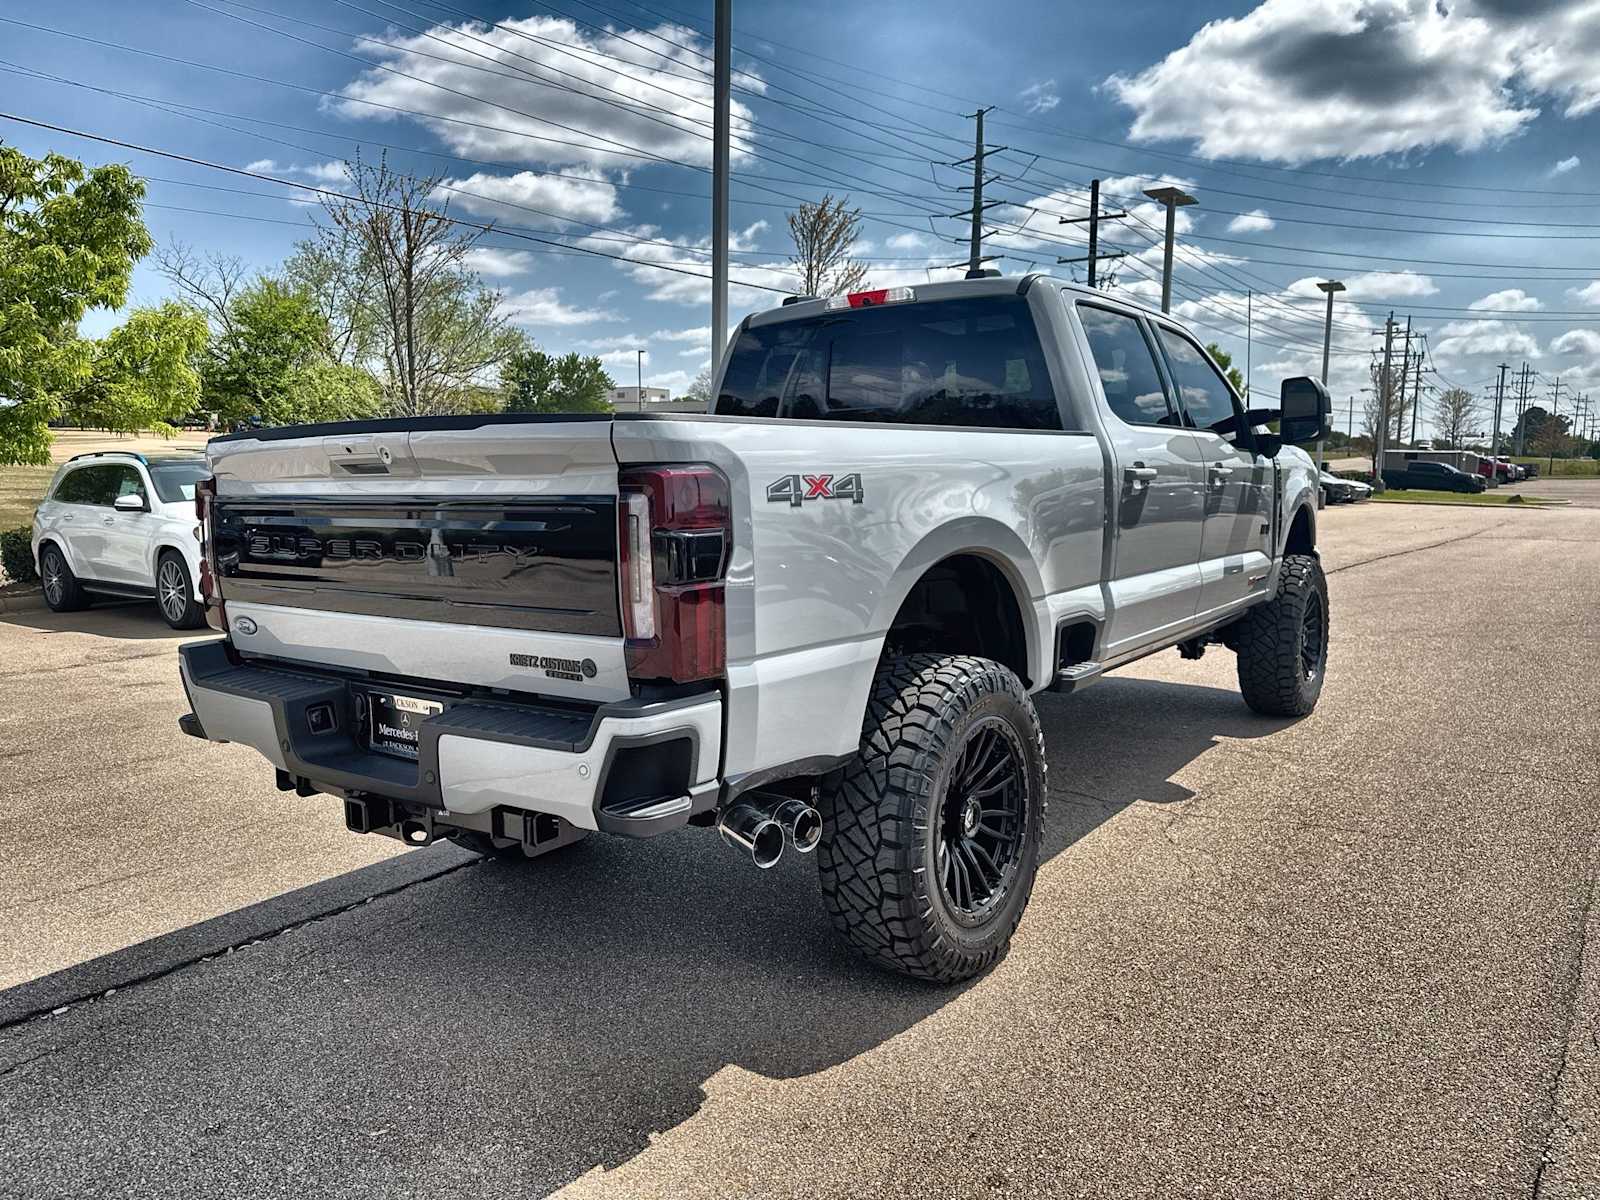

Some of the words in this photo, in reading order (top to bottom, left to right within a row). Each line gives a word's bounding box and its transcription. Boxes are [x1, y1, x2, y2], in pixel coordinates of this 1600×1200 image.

[249, 534, 383, 560] SUPER
[395, 541, 539, 567] DUTY
[540, 656, 581, 673] CUSTOMS
